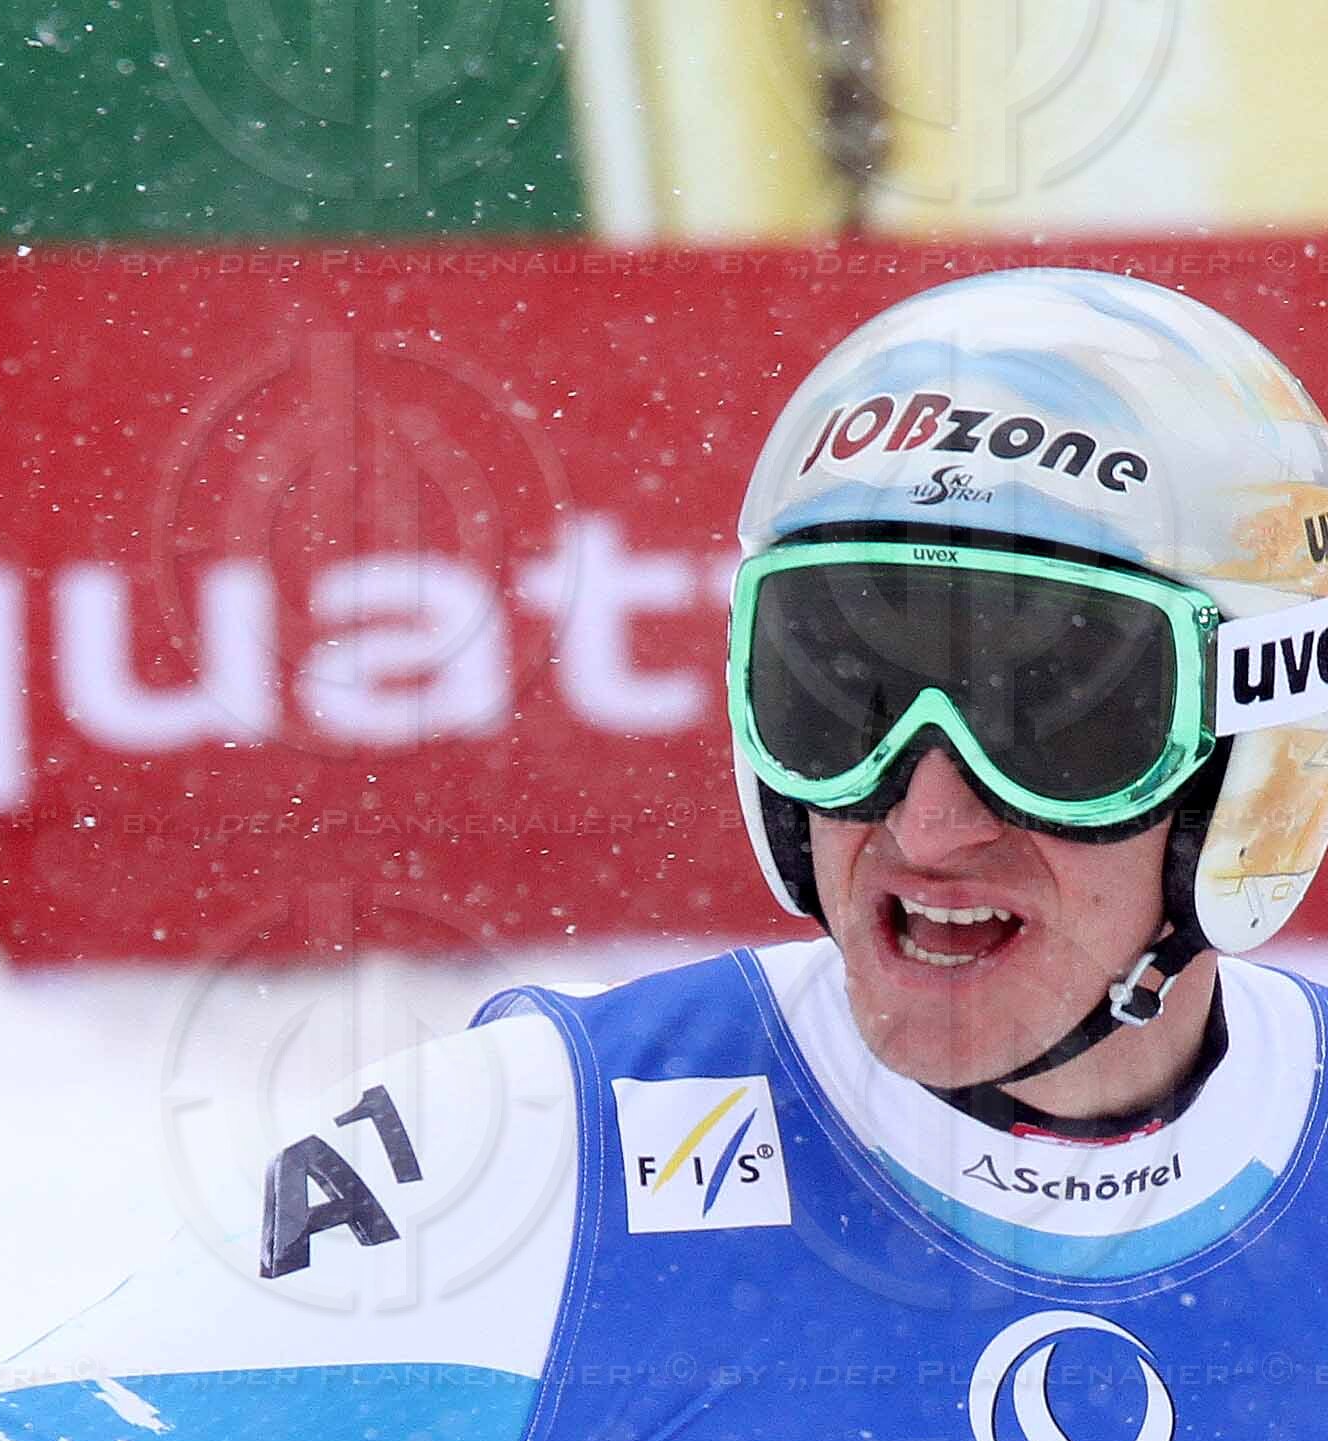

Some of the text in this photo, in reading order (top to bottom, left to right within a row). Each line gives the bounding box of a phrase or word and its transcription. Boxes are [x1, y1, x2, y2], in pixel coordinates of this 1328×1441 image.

[912, 546, 959, 563] uvex
[259, 1084, 423, 1279] A1
[1011, 1152, 1183, 1201] Schöffel
